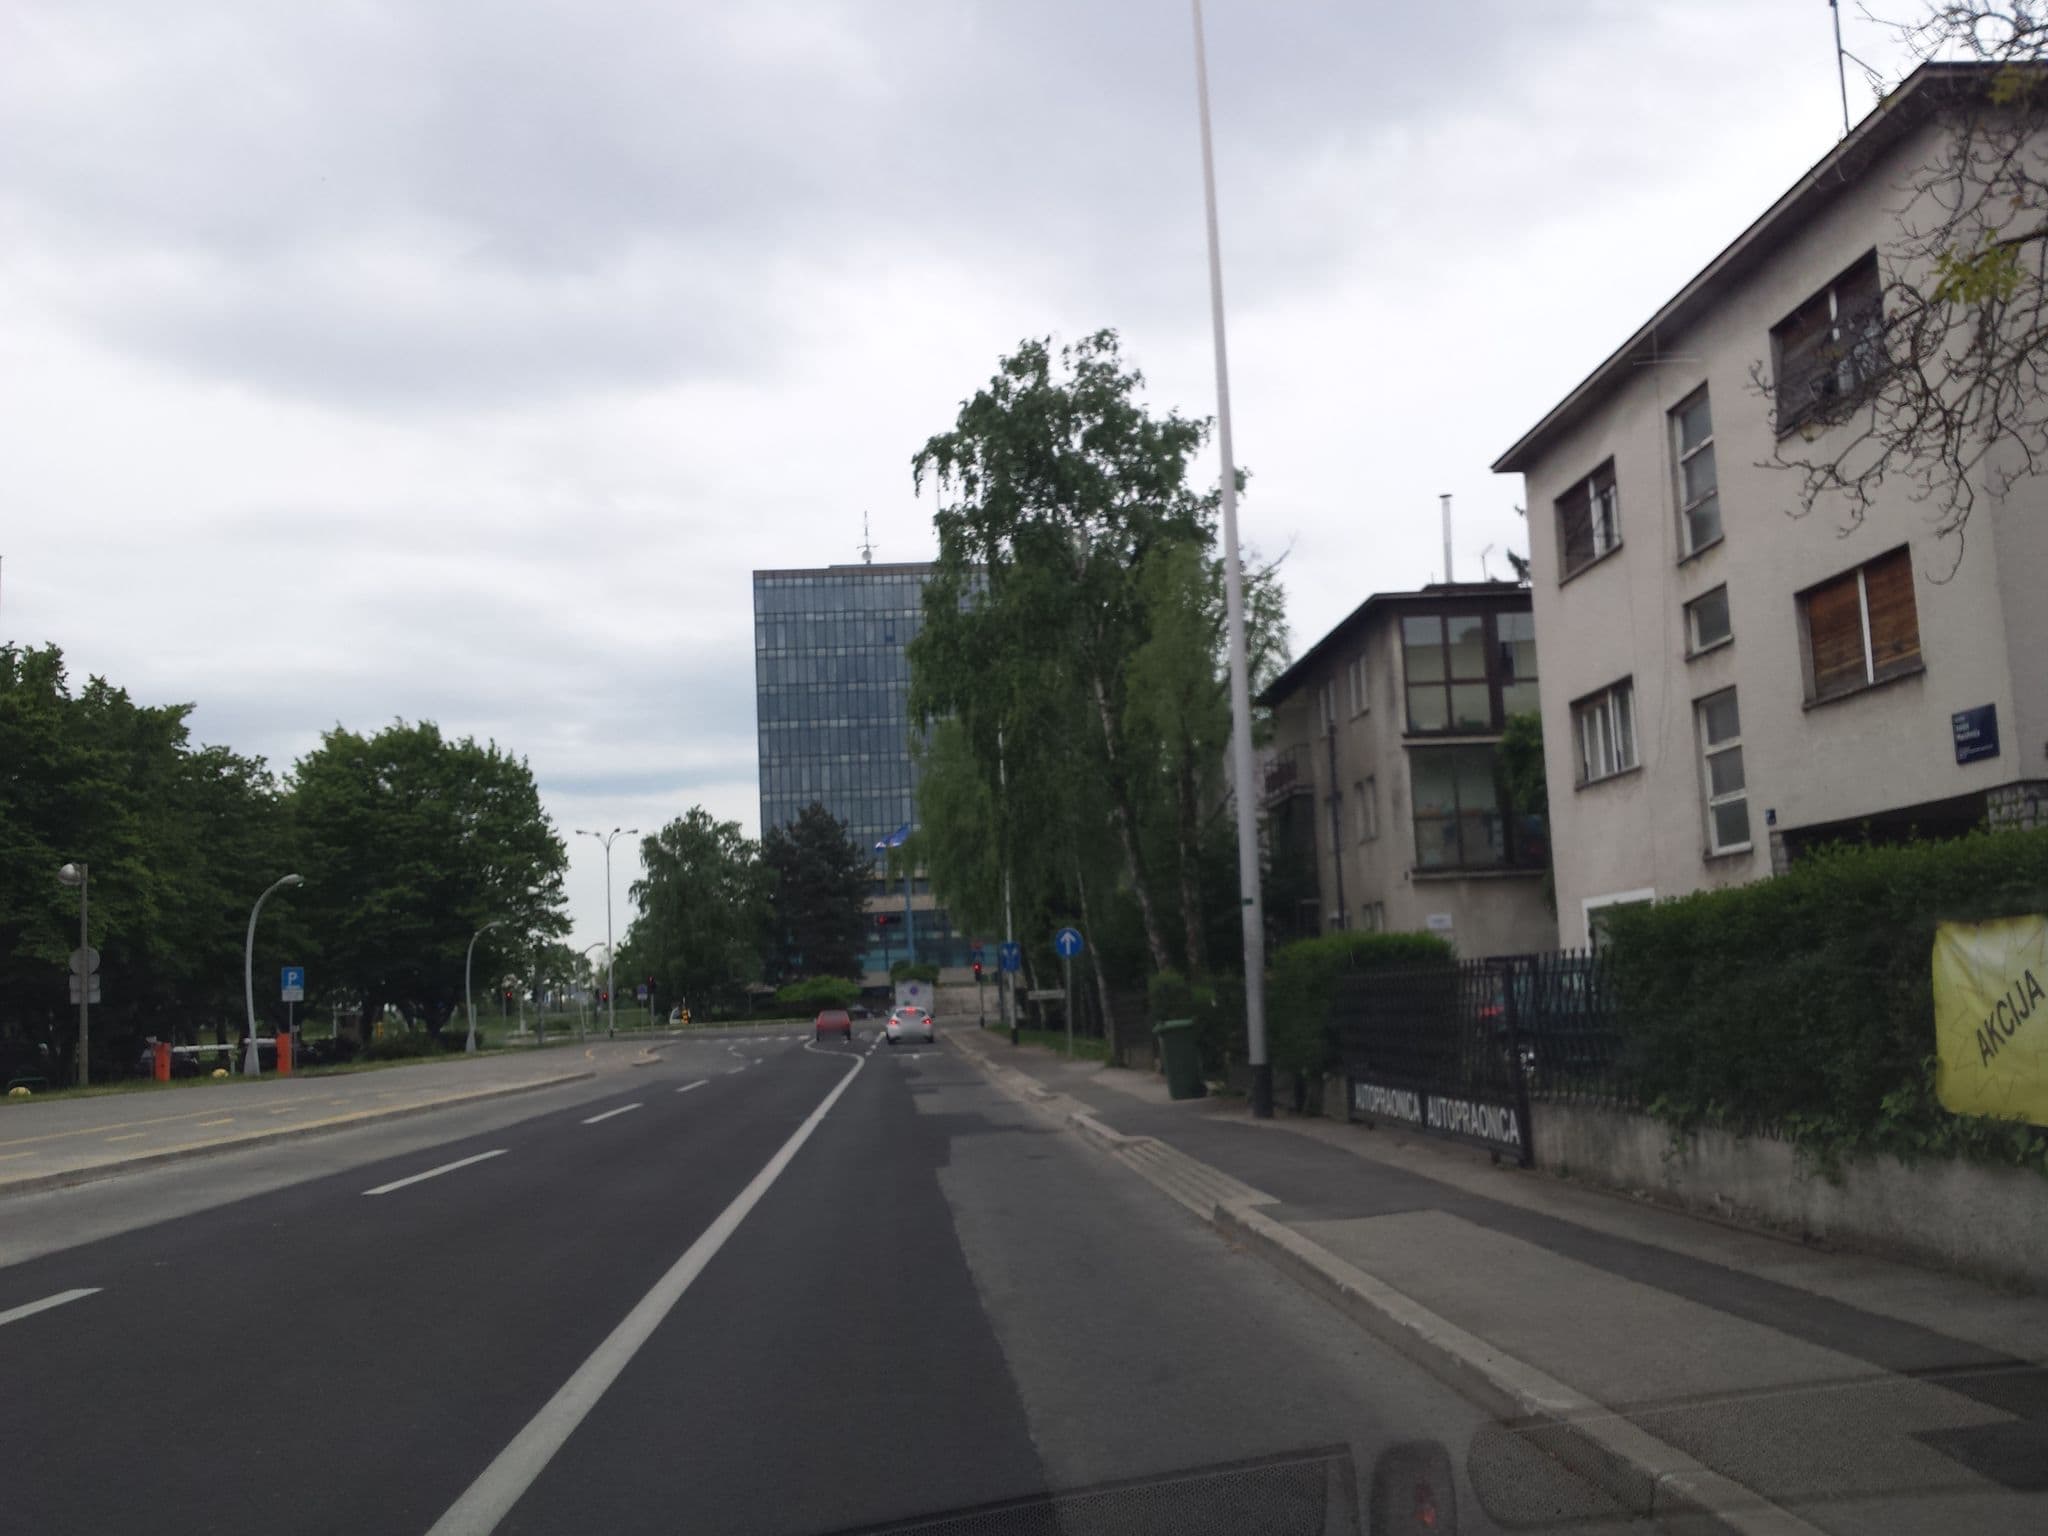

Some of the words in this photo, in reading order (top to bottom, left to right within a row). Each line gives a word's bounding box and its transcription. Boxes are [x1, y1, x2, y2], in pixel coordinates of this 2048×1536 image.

[288, 971, 298, 986] P
[1976, 968, 2046, 1068] AKCIJA
[1427, 1095, 1521, 1144] AUTOPRAONICA
